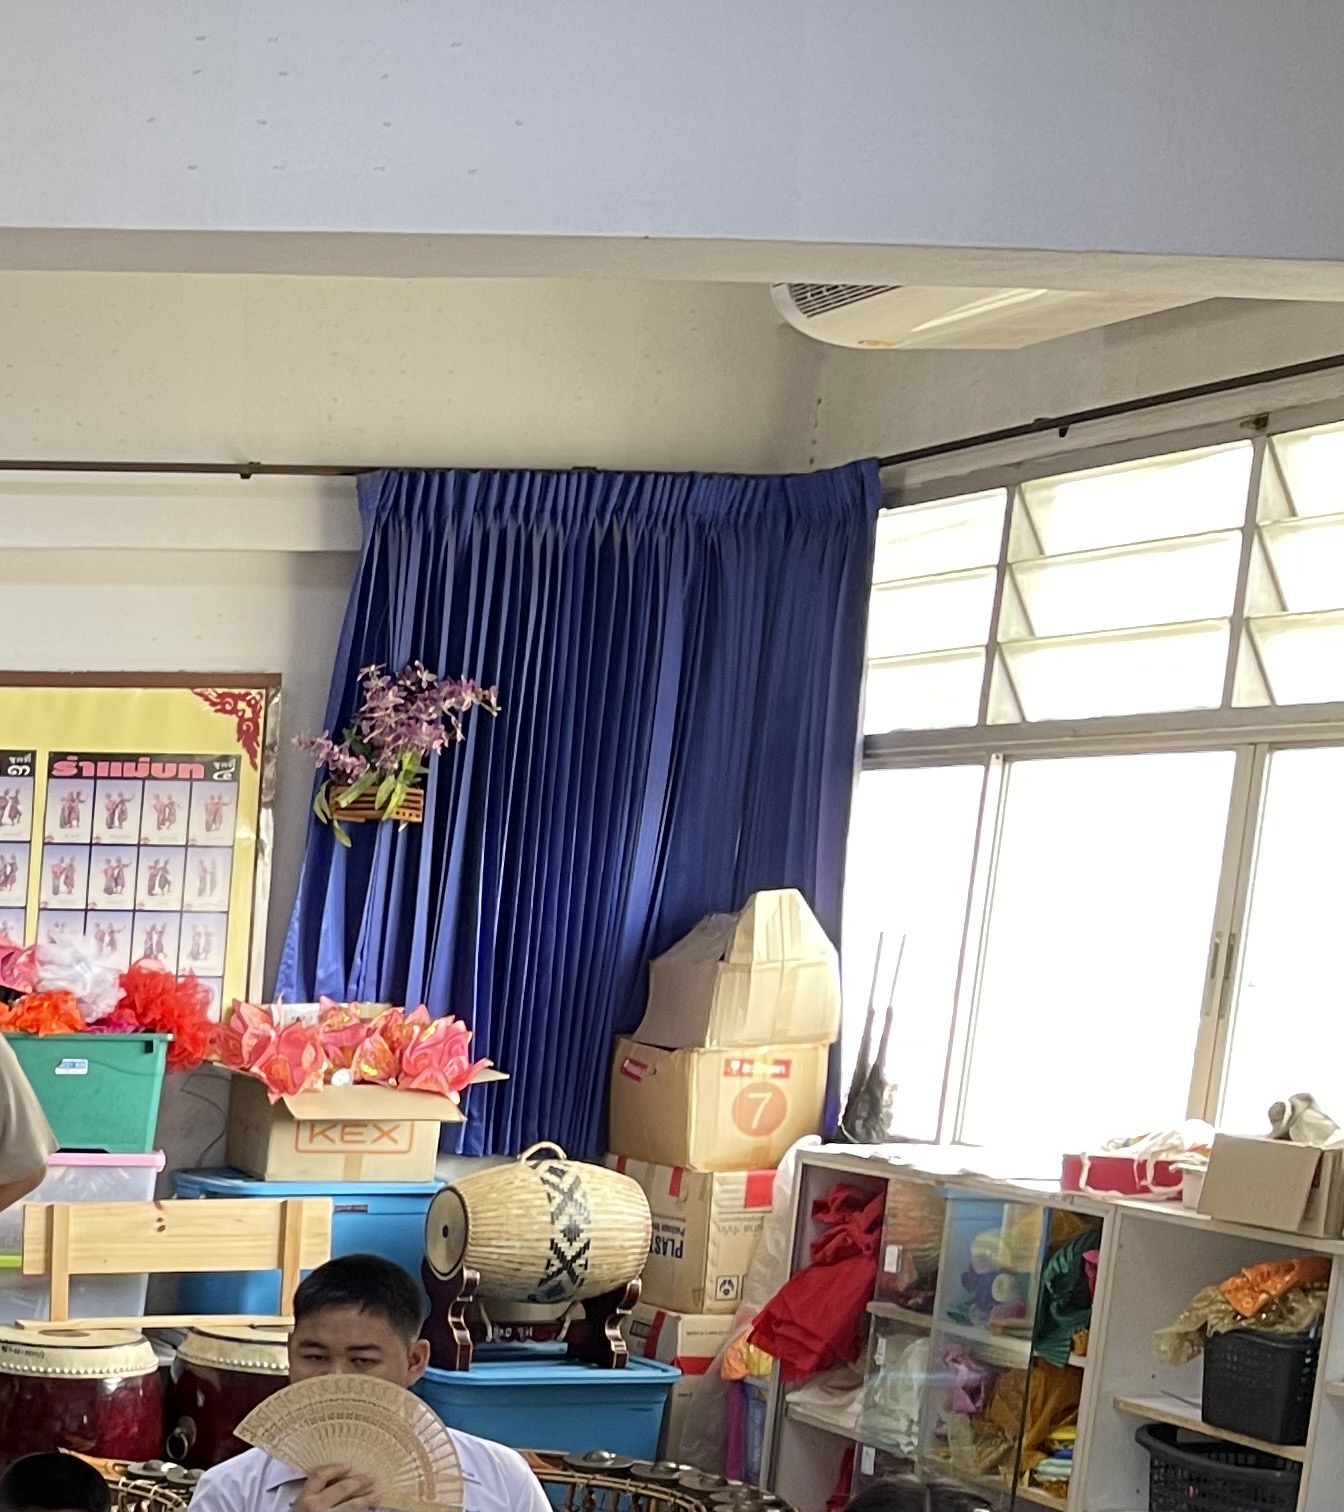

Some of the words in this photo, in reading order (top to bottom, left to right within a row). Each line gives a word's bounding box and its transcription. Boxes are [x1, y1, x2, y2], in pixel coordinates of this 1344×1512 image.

[51, 755, 205, 779] รำแม่บท
[748, 1091, 773, 1129] 7
[308, 1122, 400, 1145] KEX
